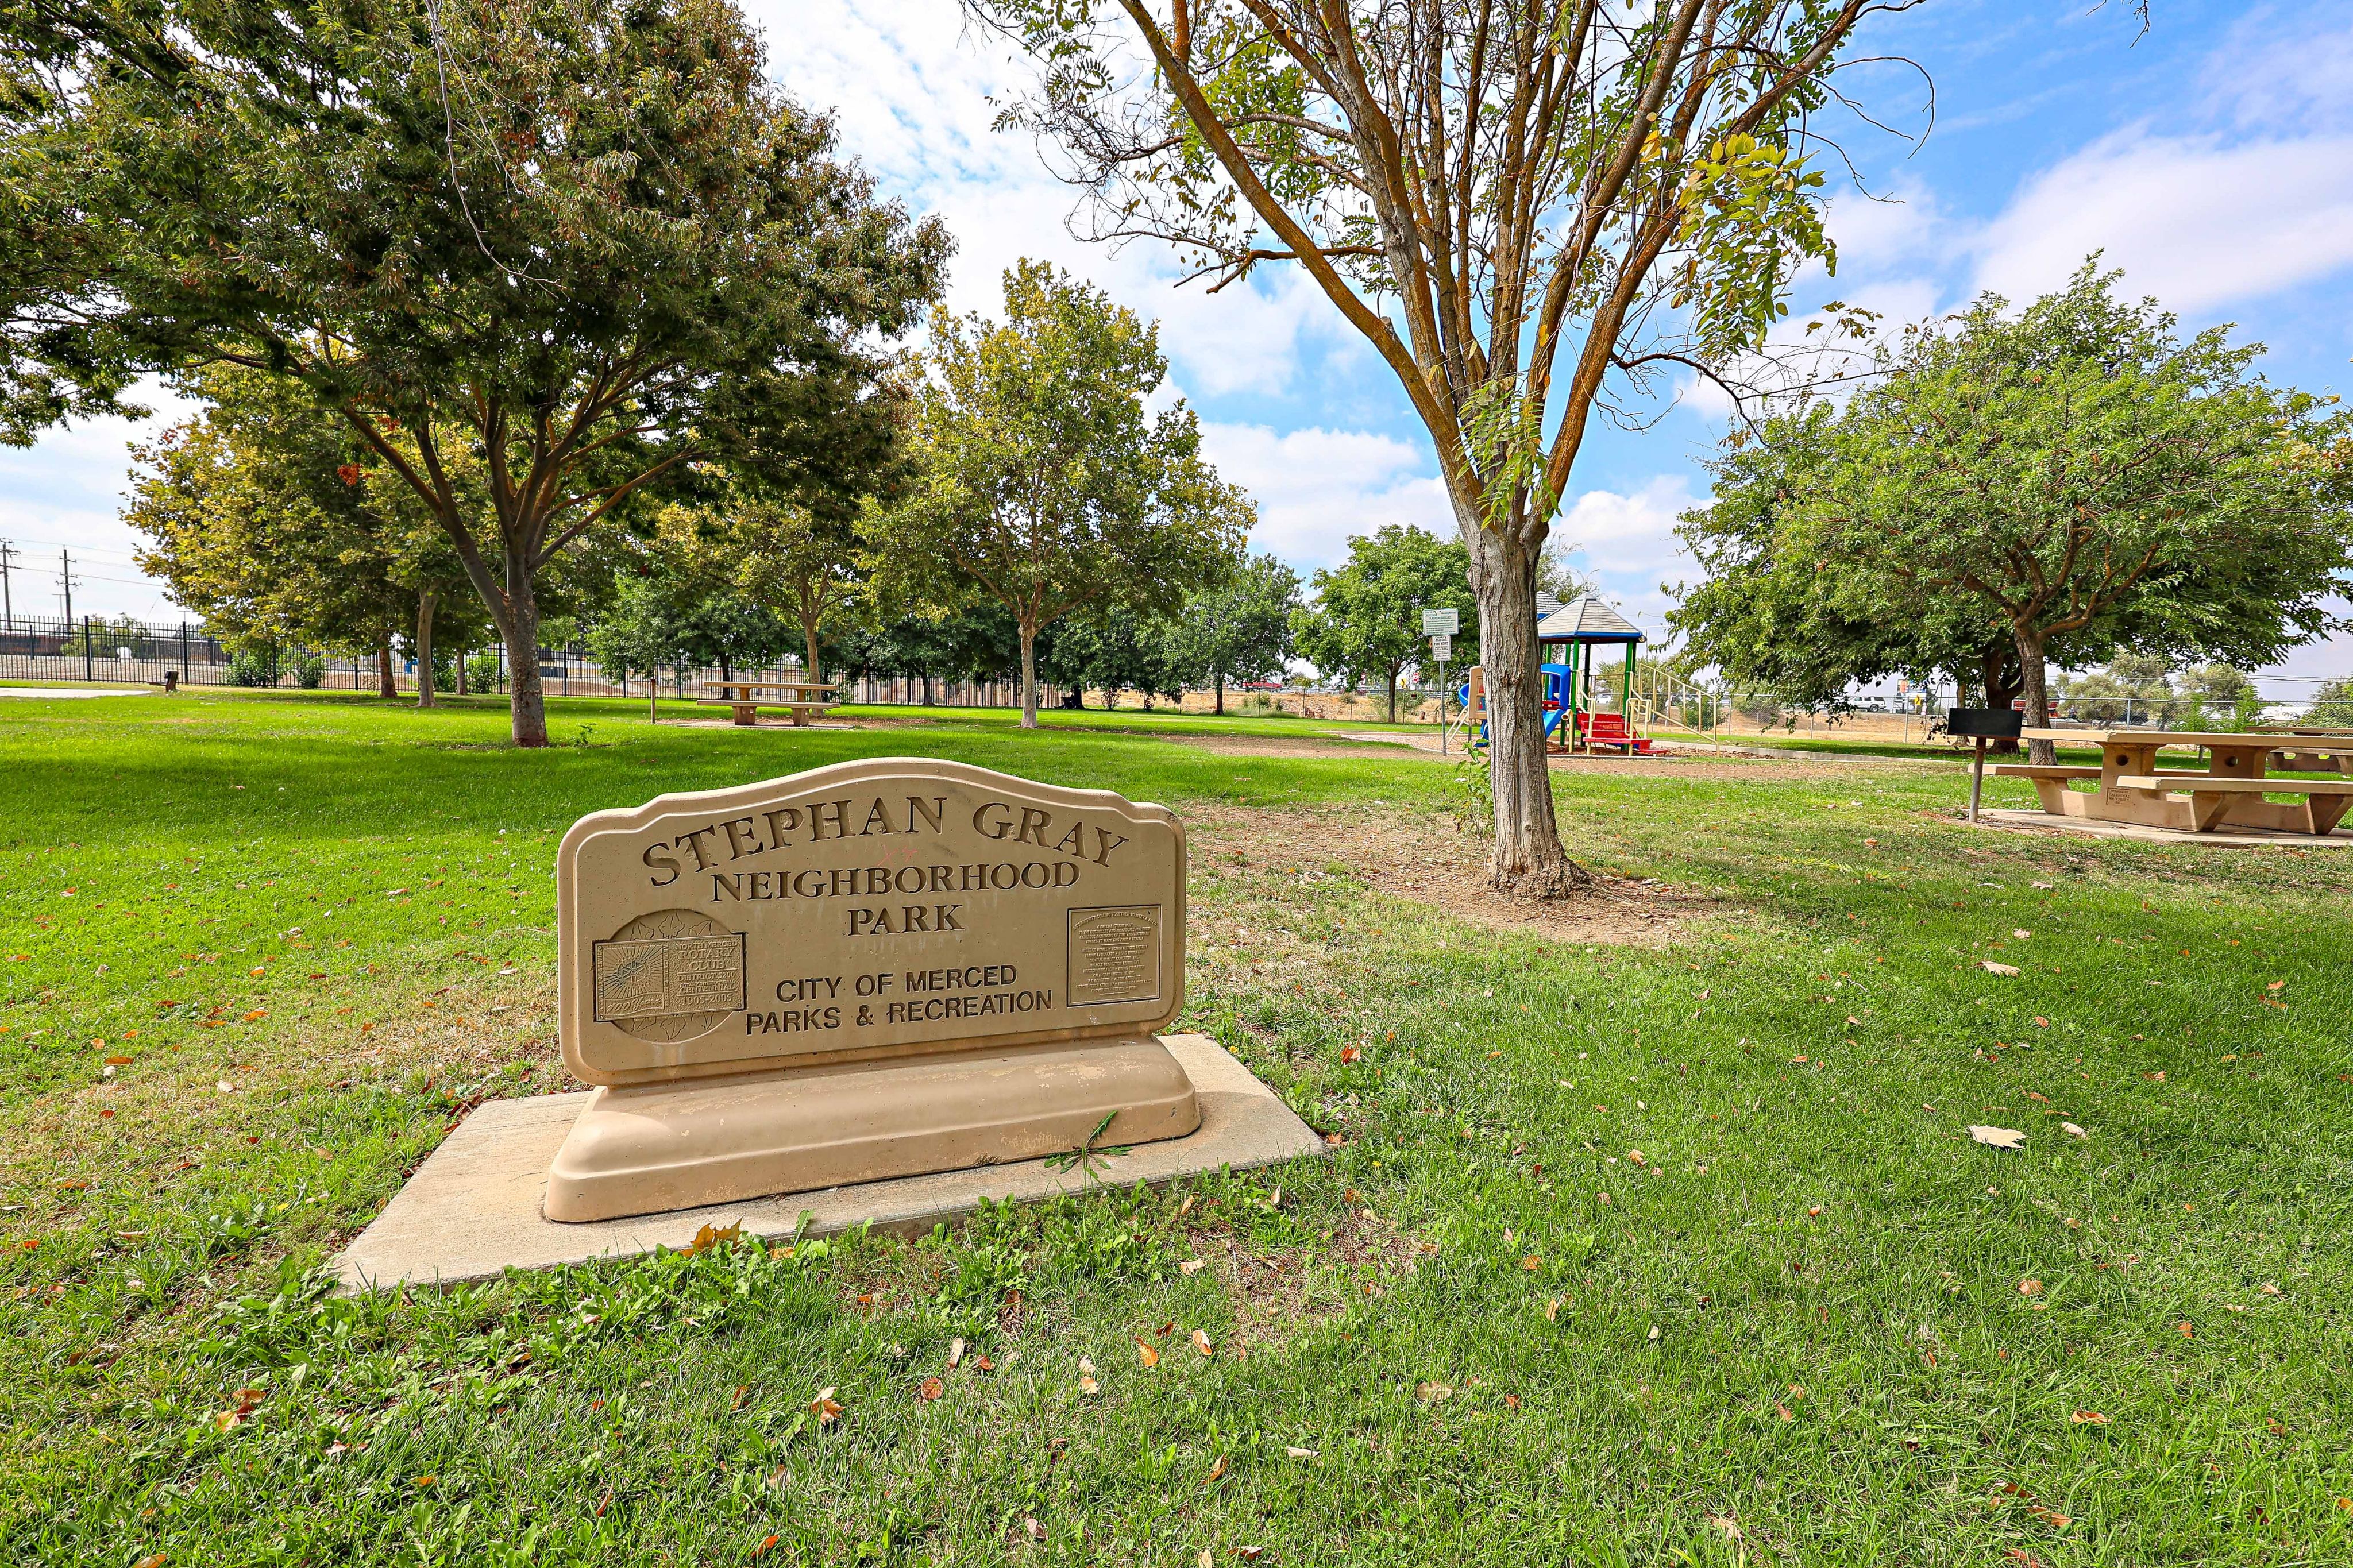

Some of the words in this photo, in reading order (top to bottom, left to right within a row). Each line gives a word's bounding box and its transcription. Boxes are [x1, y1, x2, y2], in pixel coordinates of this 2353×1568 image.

[642, 797, 947, 886] STEPHAN
[973, 802, 1130, 868] GRAY
[710, 862, 1081, 902] NEIGHBORHOOD
[847, 905, 966, 936] PARK
[680, 948, 735, 960] ROTARY
[689, 960, 726, 971] CLUB
[677, 973, 717, 982] DISTRICT
[680, 983, 735, 994] CENTENNIAL
[776, 976, 842, 1002] CITY
[855, 974, 894, 997] OF
[905, 964, 1018, 992] MERCED
[746, 1006, 842, 1035] PARKS
[856, 1004, 875, 1026] &
[888, 990, 1054, 1024] RECREATION
